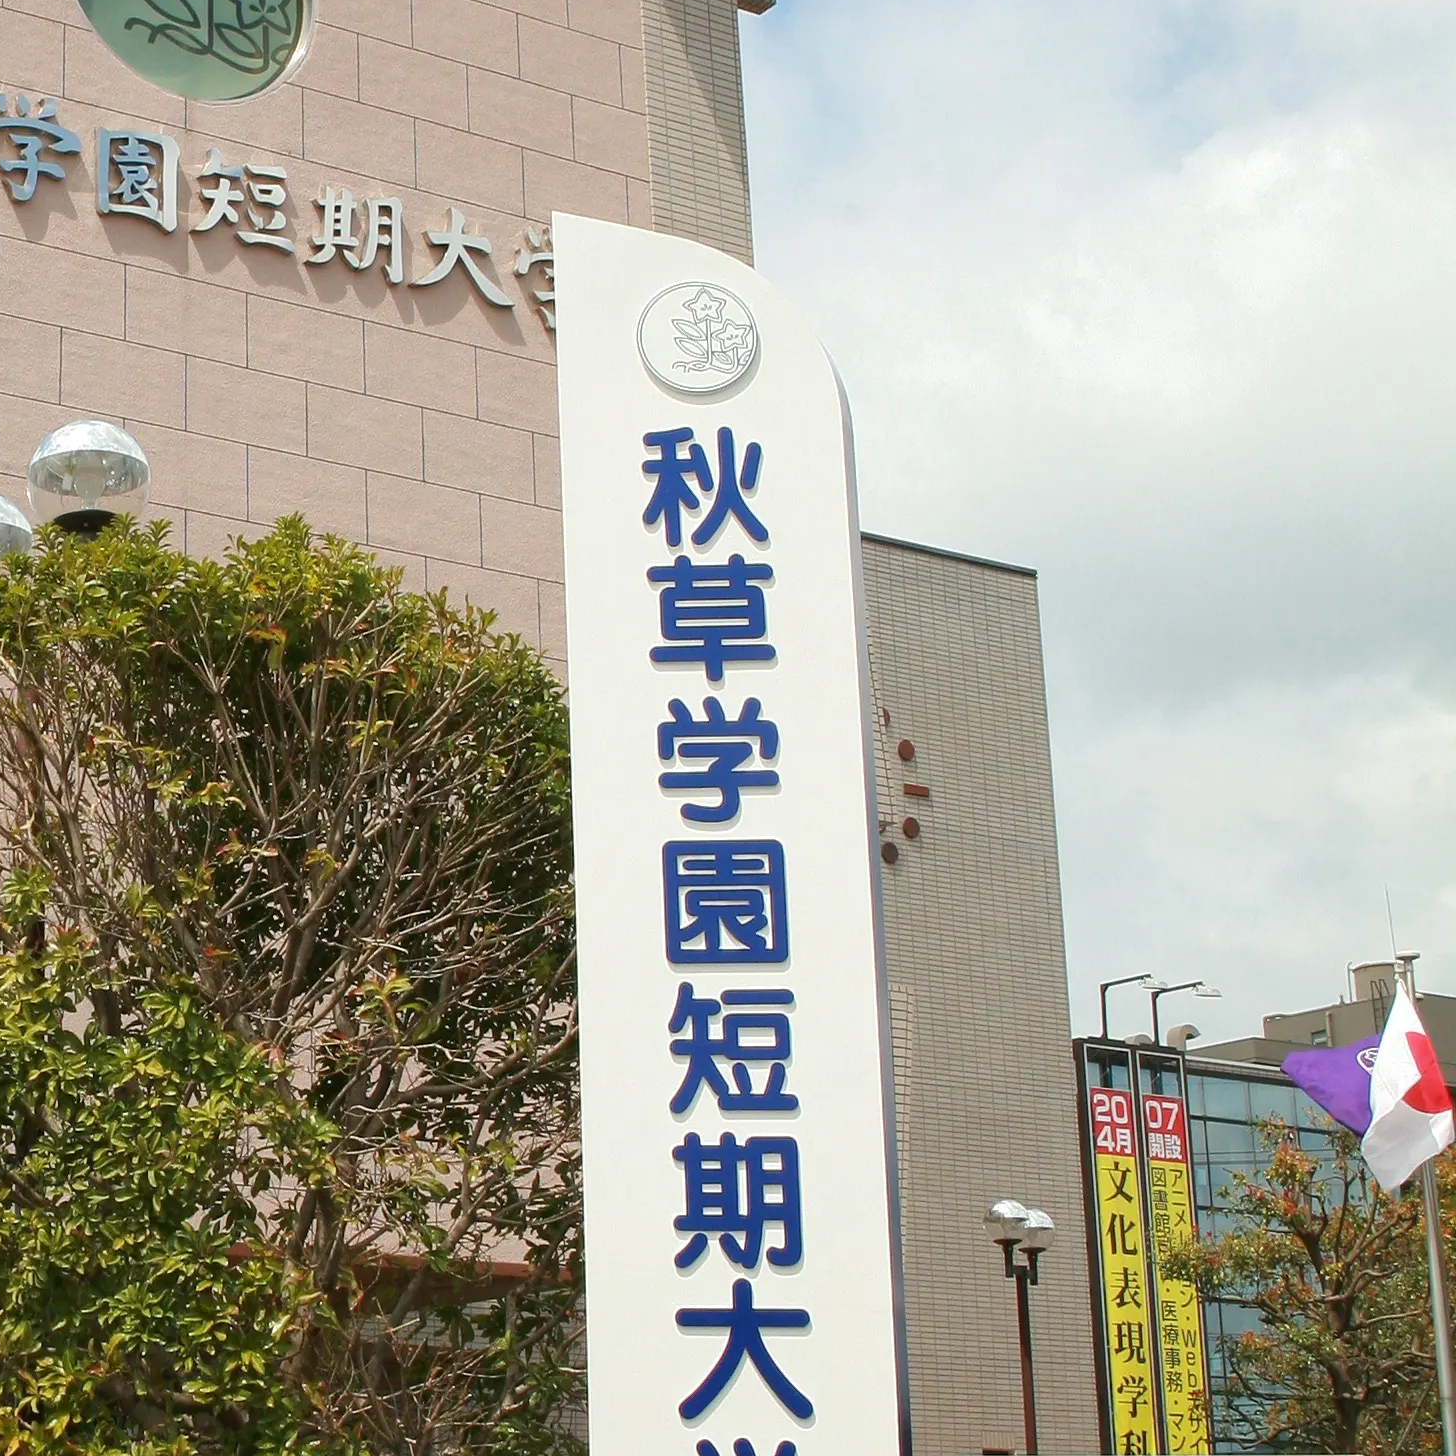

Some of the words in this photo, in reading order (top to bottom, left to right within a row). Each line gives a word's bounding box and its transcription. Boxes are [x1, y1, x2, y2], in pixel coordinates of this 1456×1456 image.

[1096, 1125, 1132, 1154] 4月
[1100, 1160, 1151, 1455] 文化表現学科
